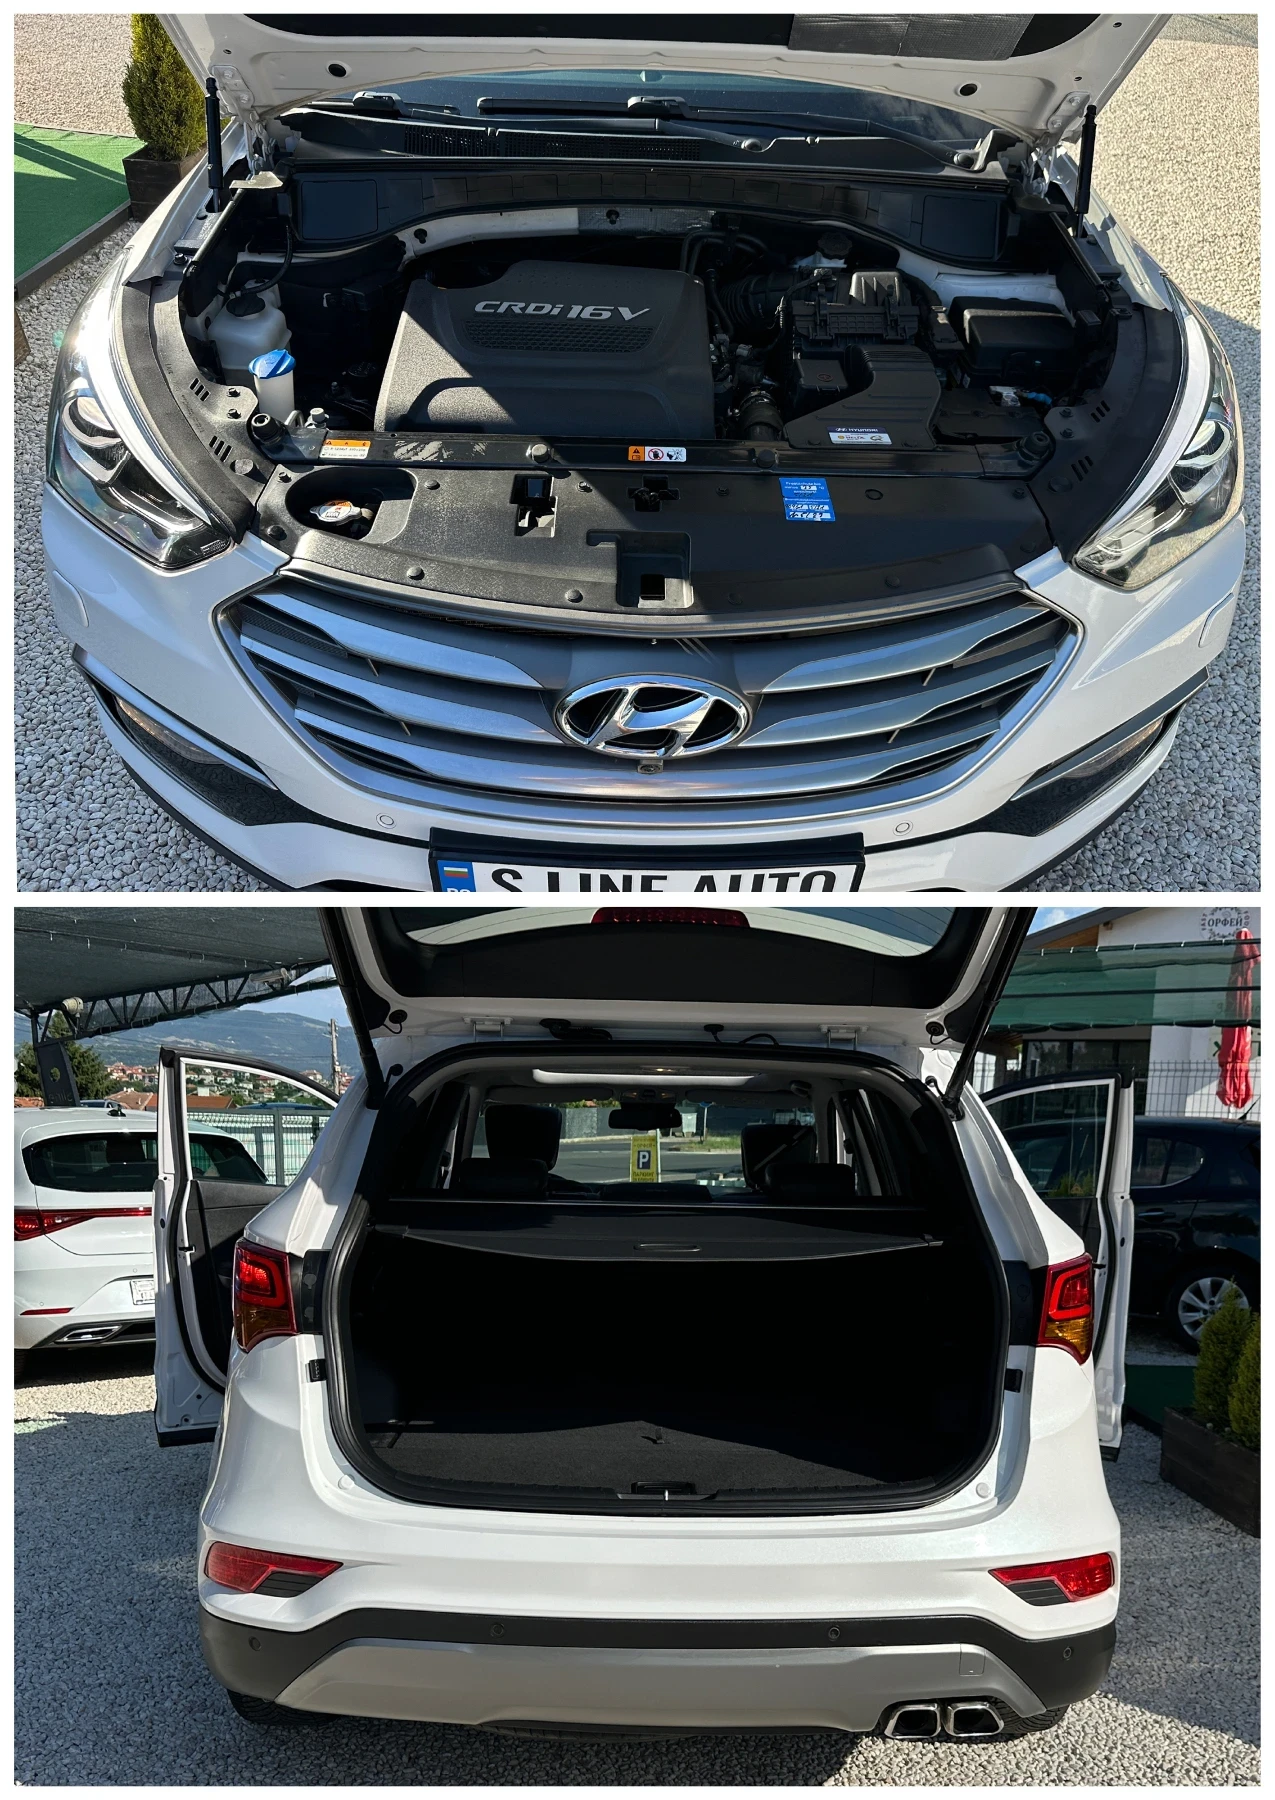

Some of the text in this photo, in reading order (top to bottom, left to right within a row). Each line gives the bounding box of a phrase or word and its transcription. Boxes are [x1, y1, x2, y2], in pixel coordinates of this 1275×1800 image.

[474, 300, 565, 316] CRDi
[1207, 916, 1243, 928] ОРФЕЙ
[639, 1151, 649, 1168] P
